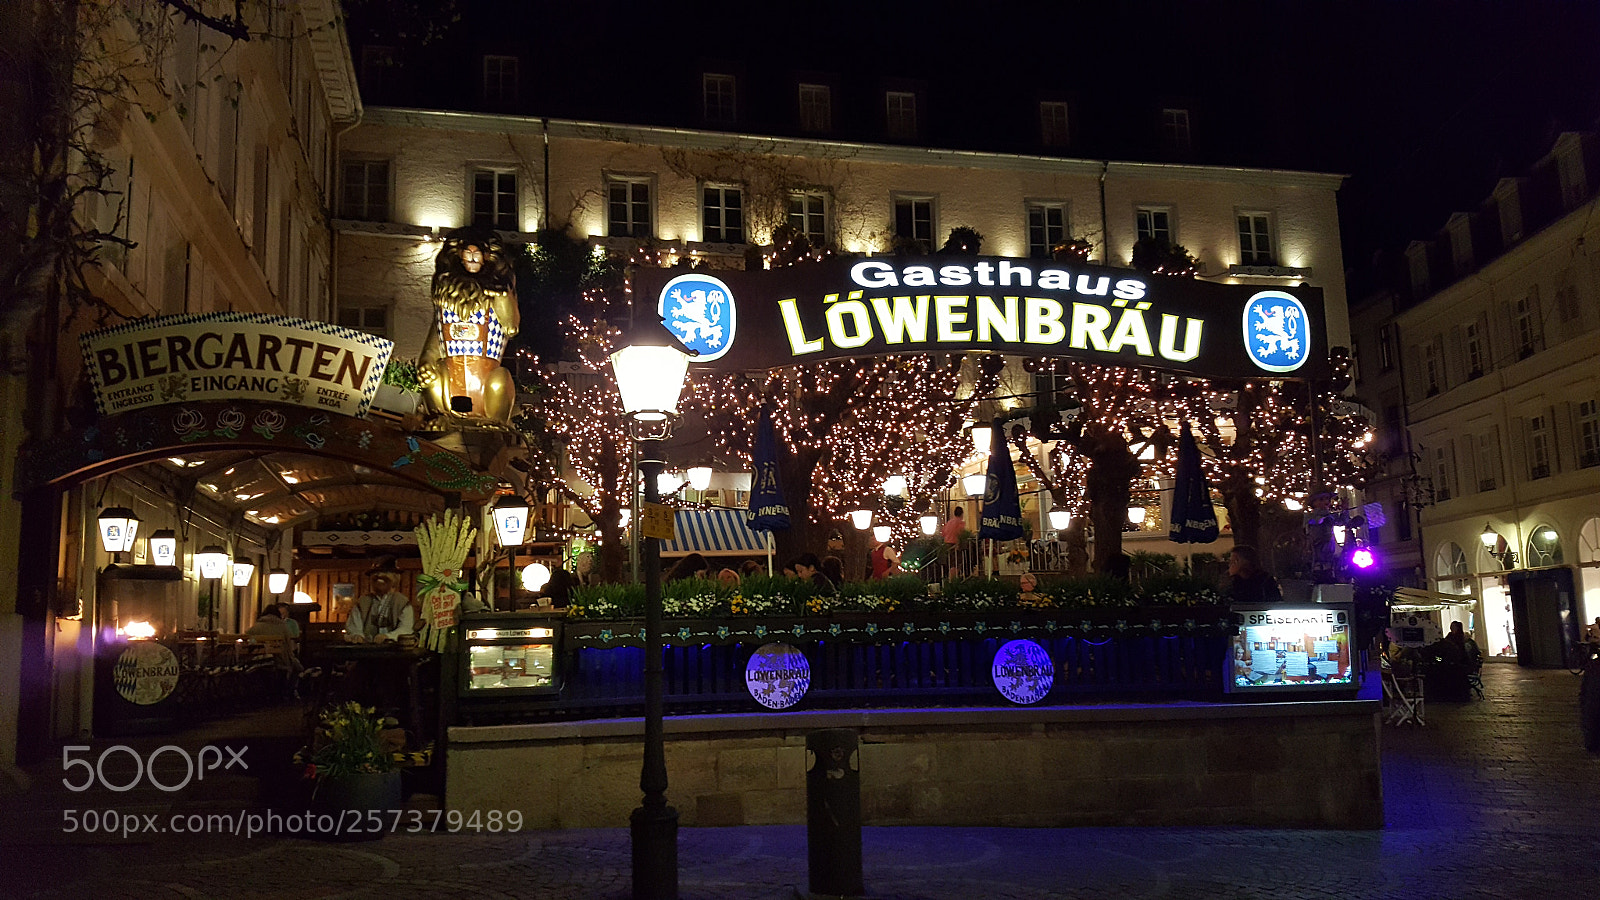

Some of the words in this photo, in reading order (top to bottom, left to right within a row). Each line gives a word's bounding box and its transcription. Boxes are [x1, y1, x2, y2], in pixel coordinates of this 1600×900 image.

[850, 261, 1147, 300] Gasthaus
[777, 289, 1205, 363] LÖWENBRÄU
[97, 332, 373, 391] BIERGARTEN
[107, 383, 155, 401] ENTRANCE
[190, 374, 279, 394] EINGANG
[112, 394, 154, 410] INGRESSO
